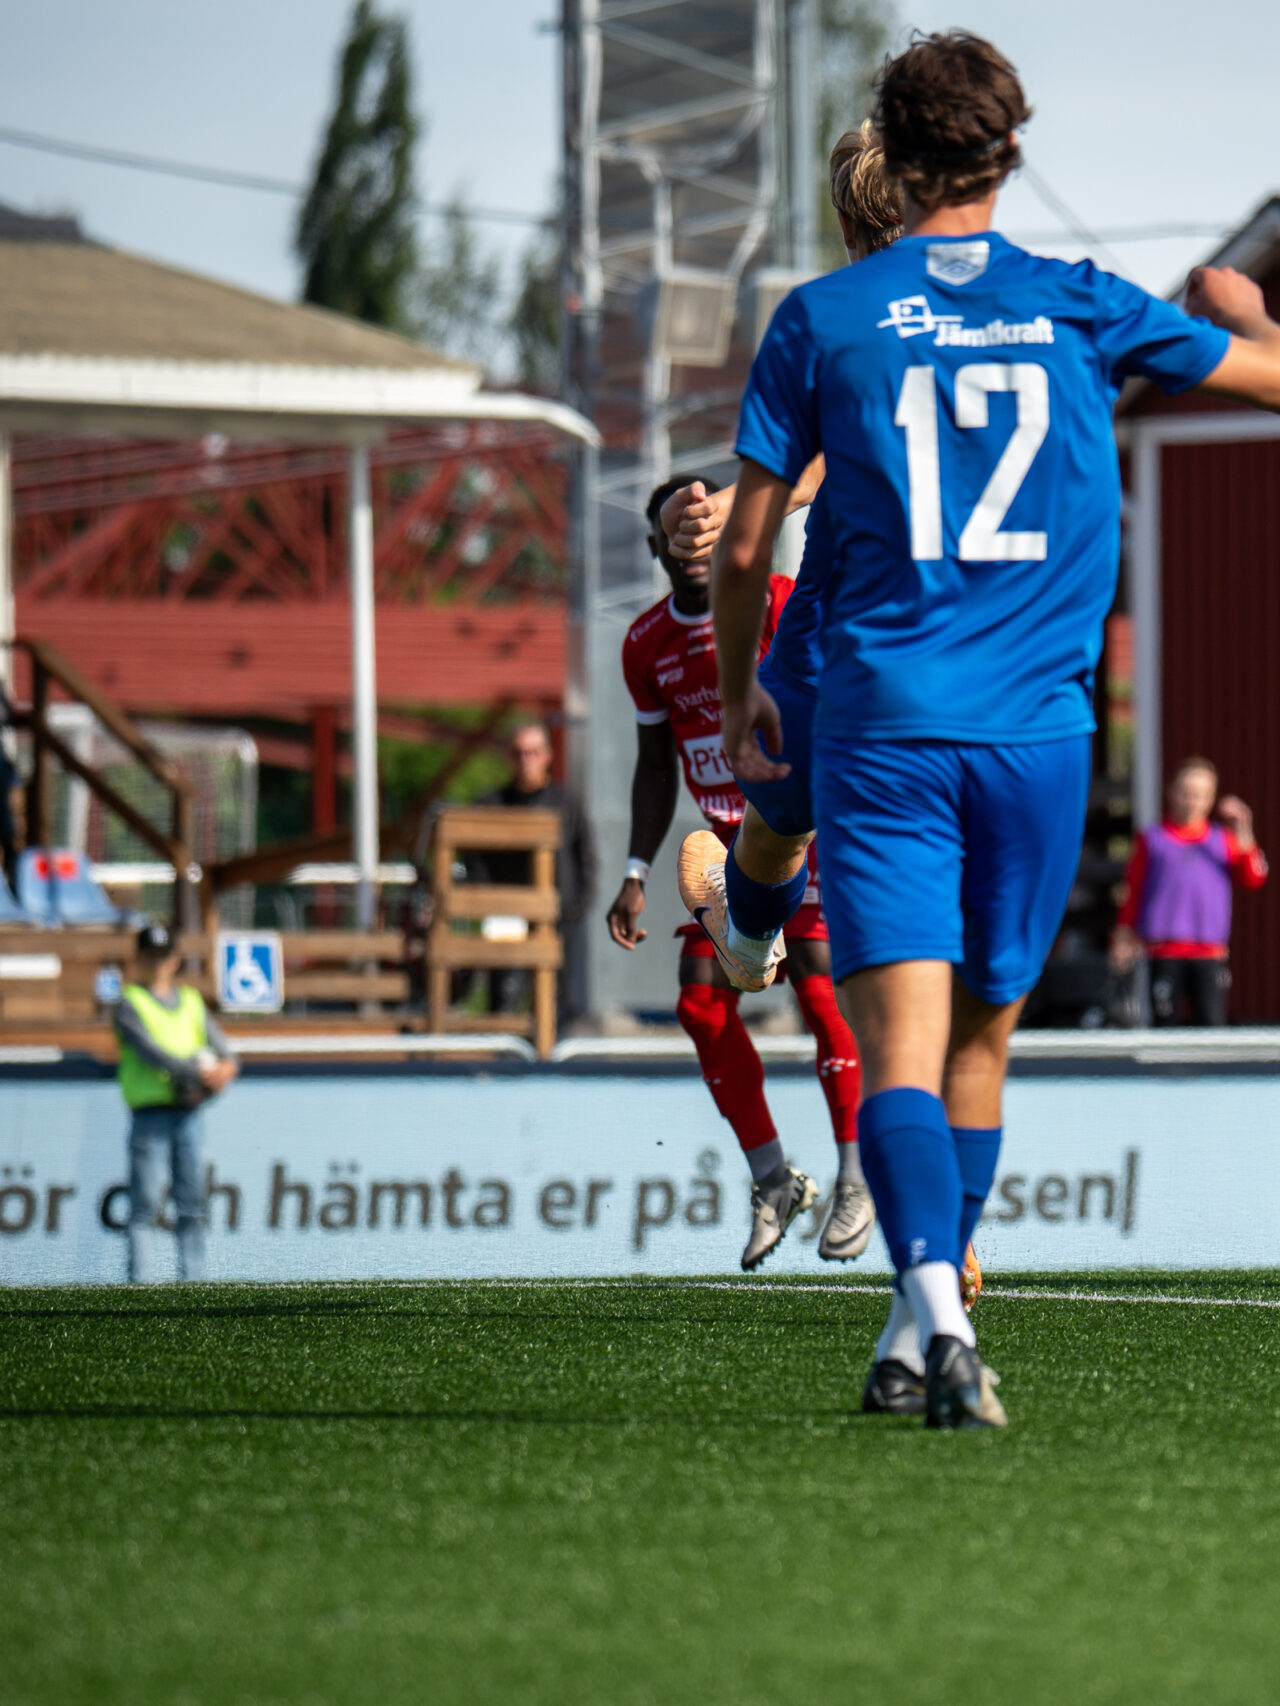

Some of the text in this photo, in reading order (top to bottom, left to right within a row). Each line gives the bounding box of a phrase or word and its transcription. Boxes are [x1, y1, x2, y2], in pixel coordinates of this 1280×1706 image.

[933, 316, 1055, 347] Jämtkraft
[895, 362, 1049, 561] 12
[693, 746, 734, 778] Pit
[0, 1166, 75, 1233] ör
[268, 1163, 513, 1232] hämta
[538, 1180, 612, 1230] er
[635, 1149, 722, 1251] på
